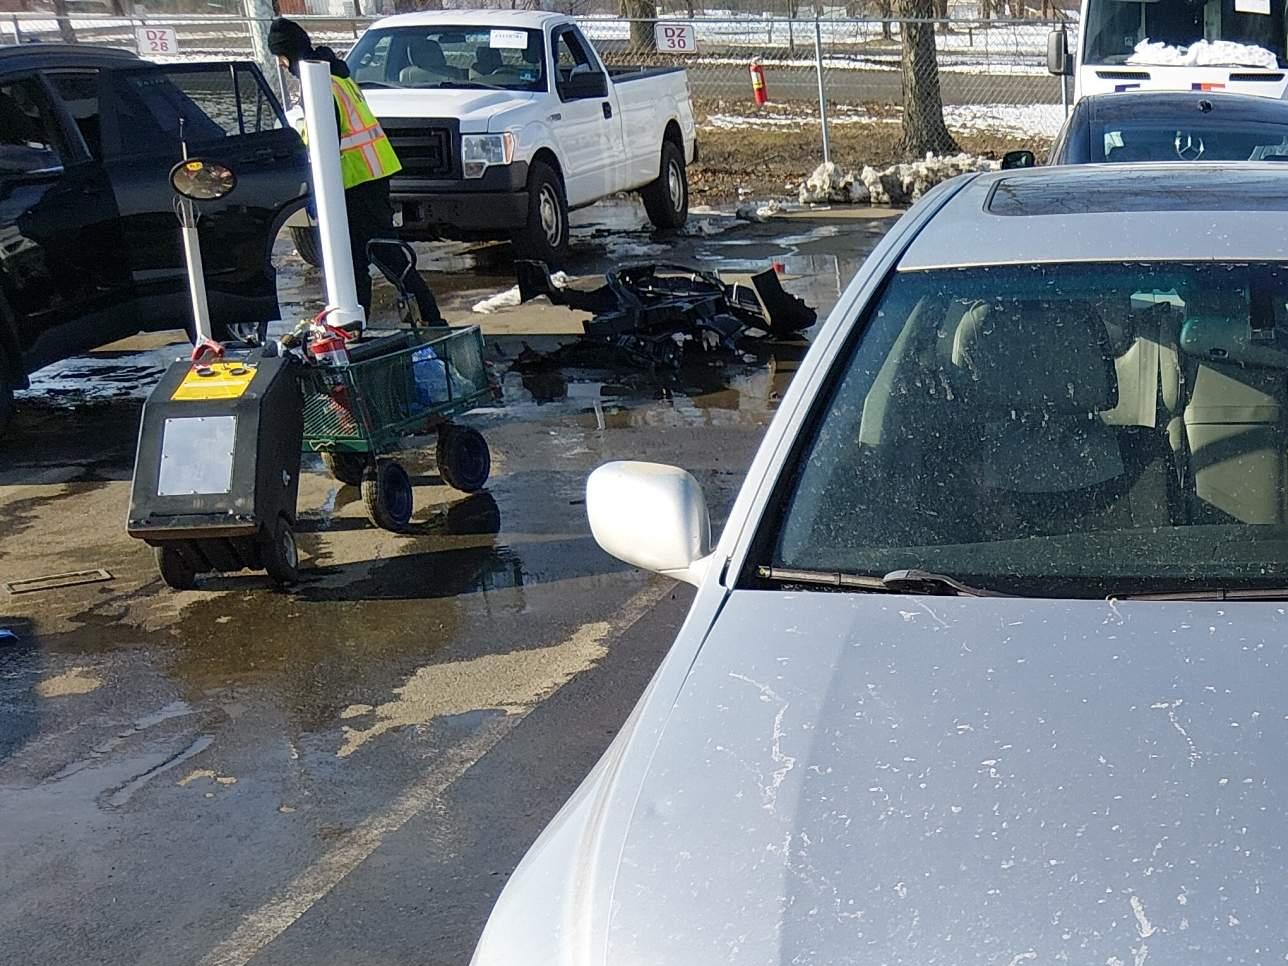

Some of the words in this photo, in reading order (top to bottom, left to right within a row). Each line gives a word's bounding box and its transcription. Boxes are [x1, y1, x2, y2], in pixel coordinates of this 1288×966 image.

[146, 30, 168, 41] DZ
[664, 27, 687, 38] DZ
[150, 41, 169, 52] 28
[667, 38, 686, 49] 30
